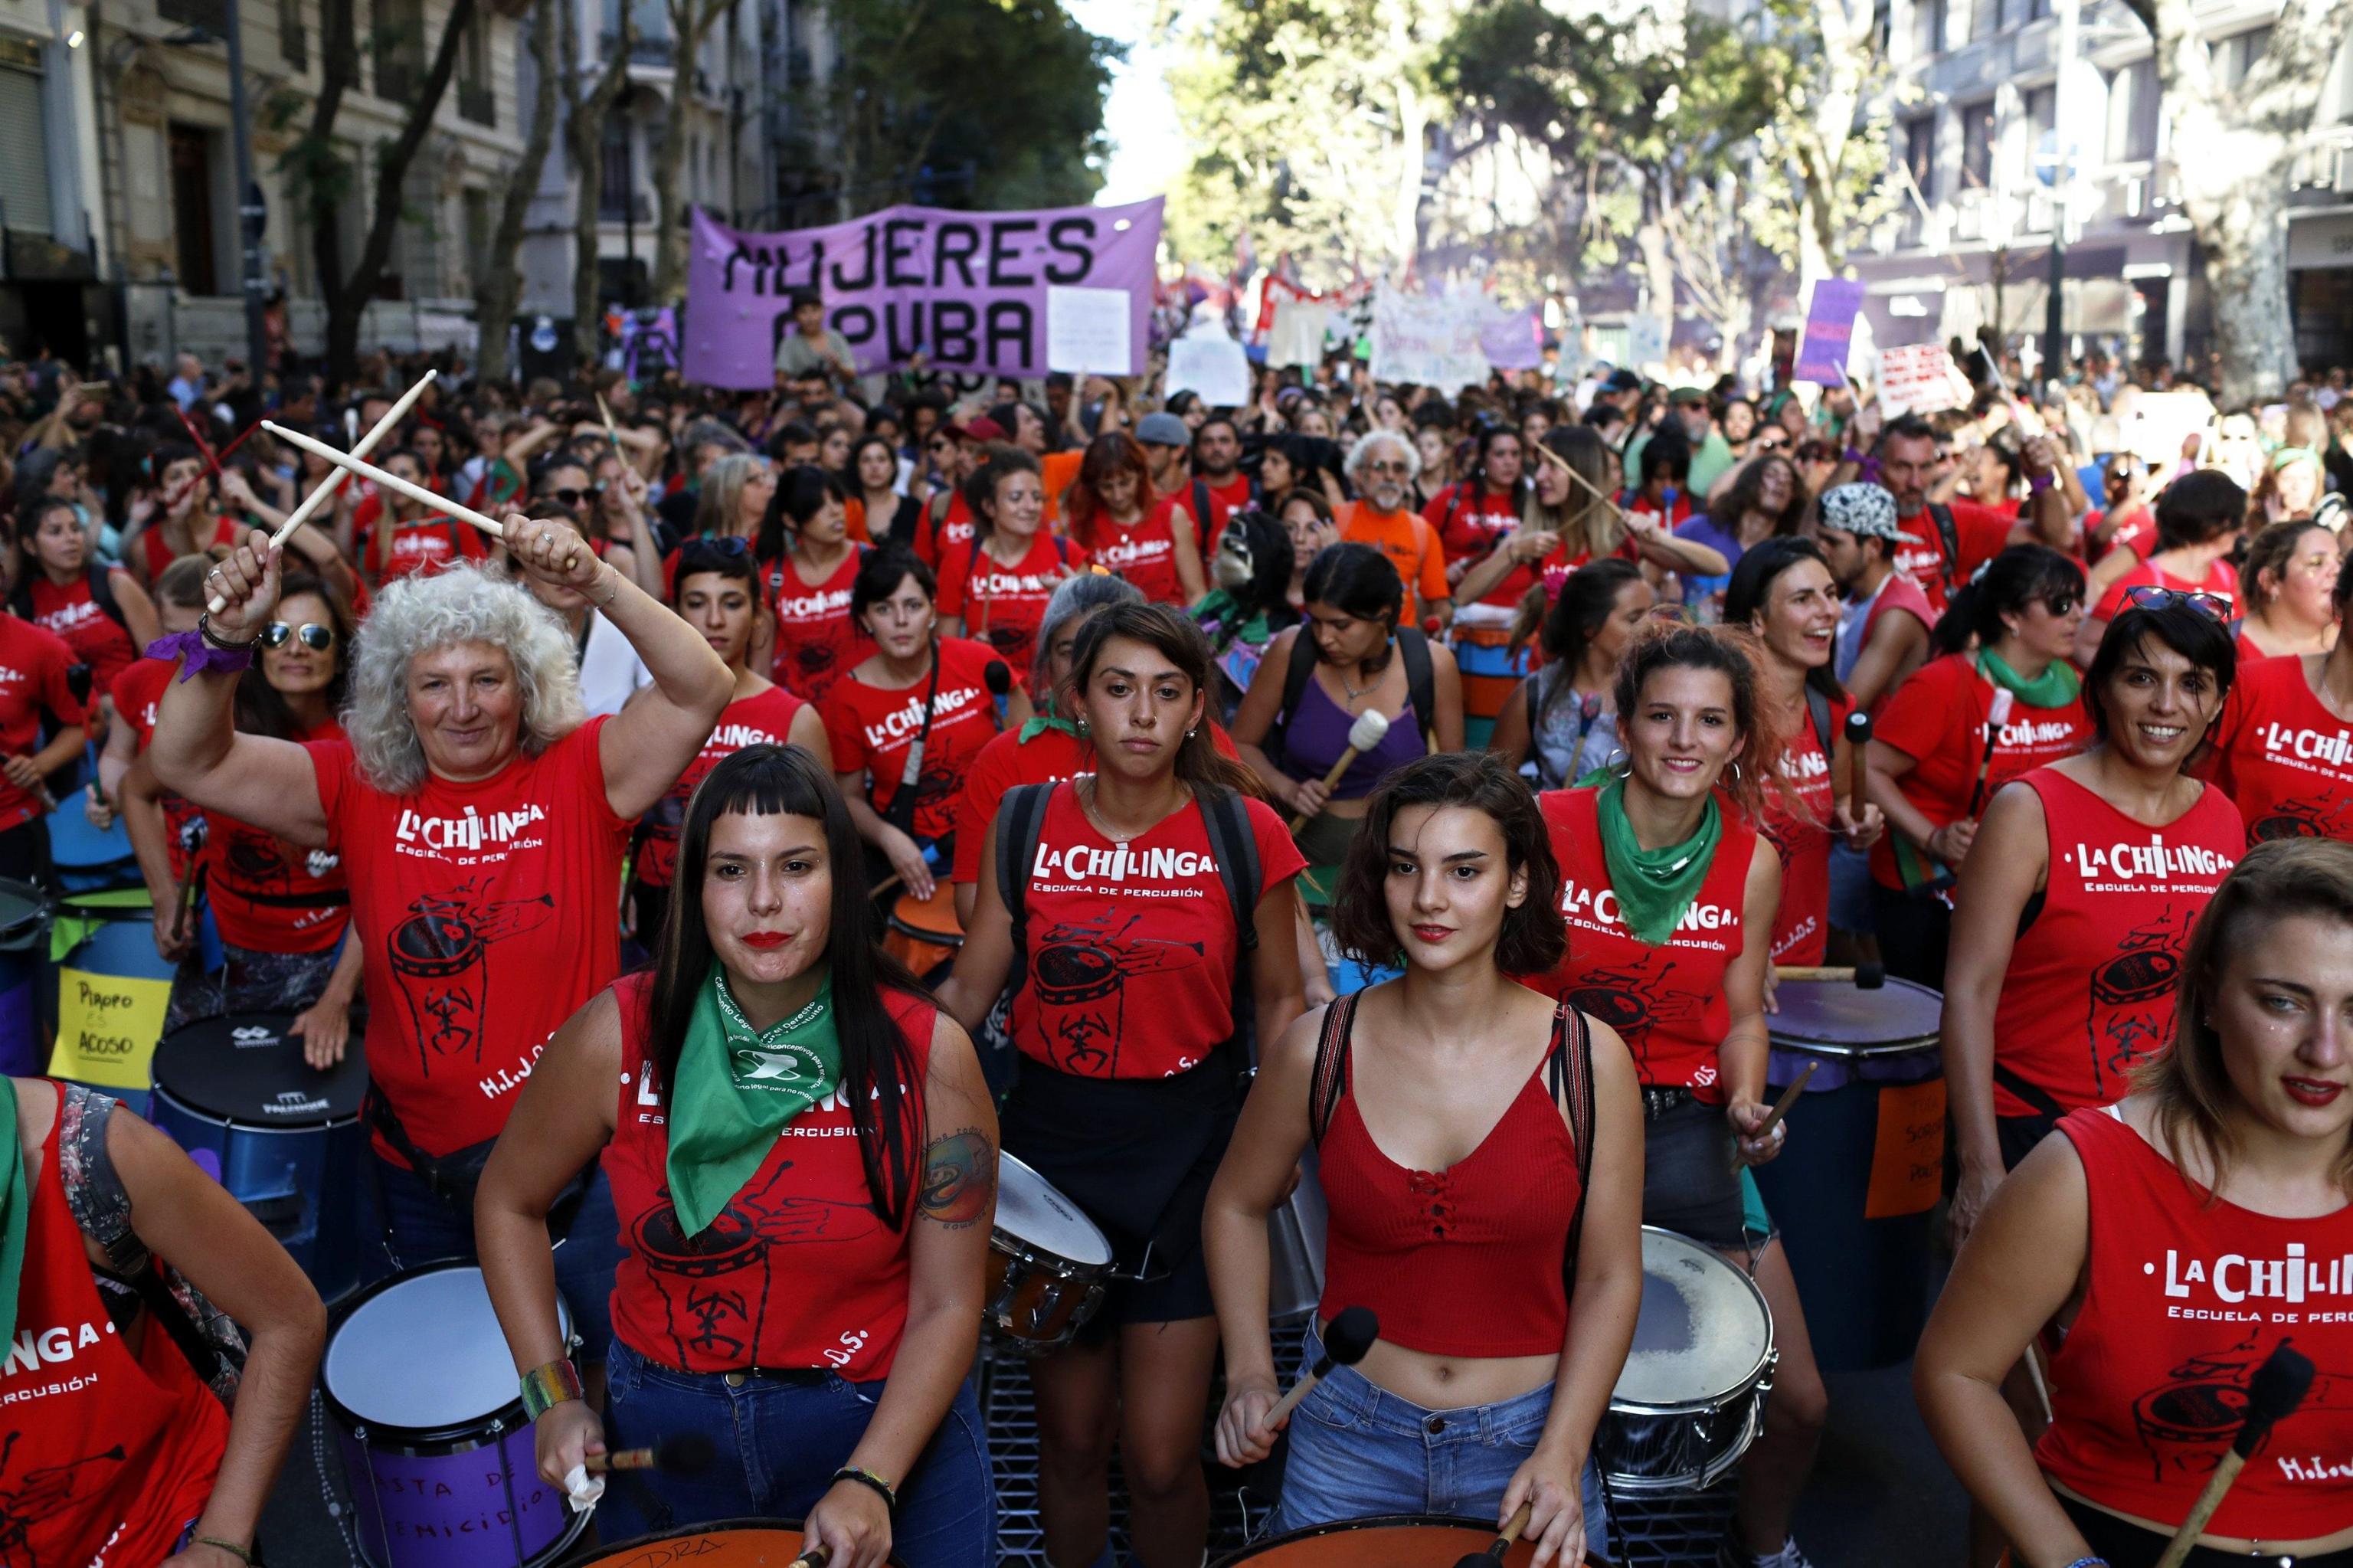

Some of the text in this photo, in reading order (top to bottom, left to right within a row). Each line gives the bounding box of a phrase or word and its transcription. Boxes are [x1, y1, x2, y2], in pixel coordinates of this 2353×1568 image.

[1033, 882, 1203, 898] ESCUELA DE PERCUSIÓN
[2085, 882, 2146, 892] ESCUELA
[2151, 884, 2167, 892] DE
[783, 1001, 816, 1028] Derecho
[78, 1030, 134, 1054] ACOSO
[639, 1114, 664, 1124] ES
[2168, 1306, 2262, 1322] ESCUELA
[2272, 1313, 2298, 1323] DE
[0, 1373, 98, 1407] RCUSIÓN
